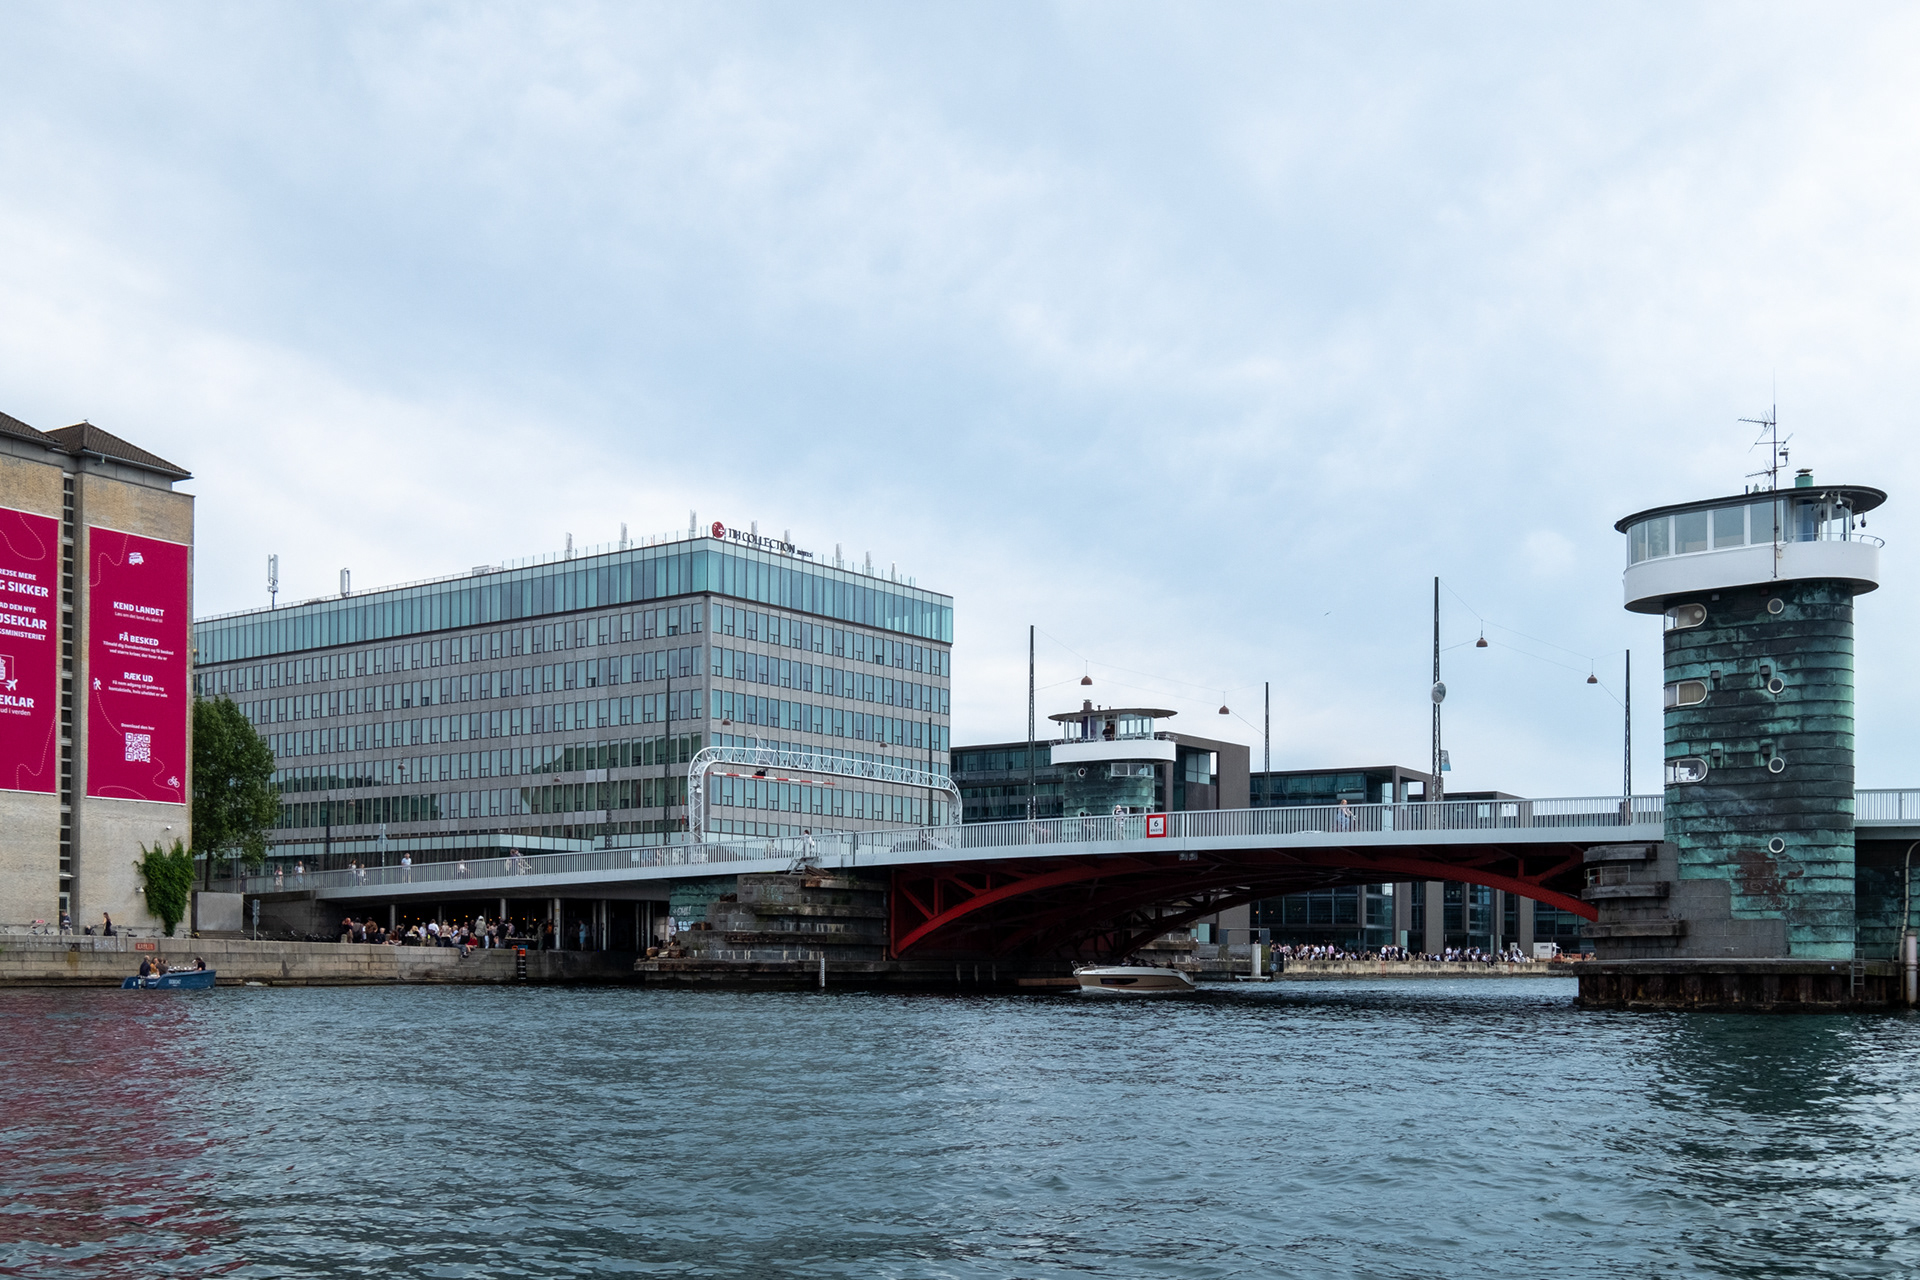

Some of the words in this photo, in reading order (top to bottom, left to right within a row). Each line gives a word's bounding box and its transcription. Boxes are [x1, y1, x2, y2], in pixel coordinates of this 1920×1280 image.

[742, 531, 795, 553] COLLECTION
[18, 571, 37, 581] MERE
[8, 581, 49, 598] SIKKER
[9, 603, 23, 611] DEN
[23, 606, 37, 614] NYE
[113, 601, 134, 612] KEND
[135, 605, 164, 617] LANDET
[119, 631, 129, 642] FÅ
[130, 635, 159, 646] BESKED
[123, 671, 141, 681] RÆK
[142, 674, 153, 683] UD
[0, 694, 34, 709] EKLAR
[11, 709, 31, 717] verden
